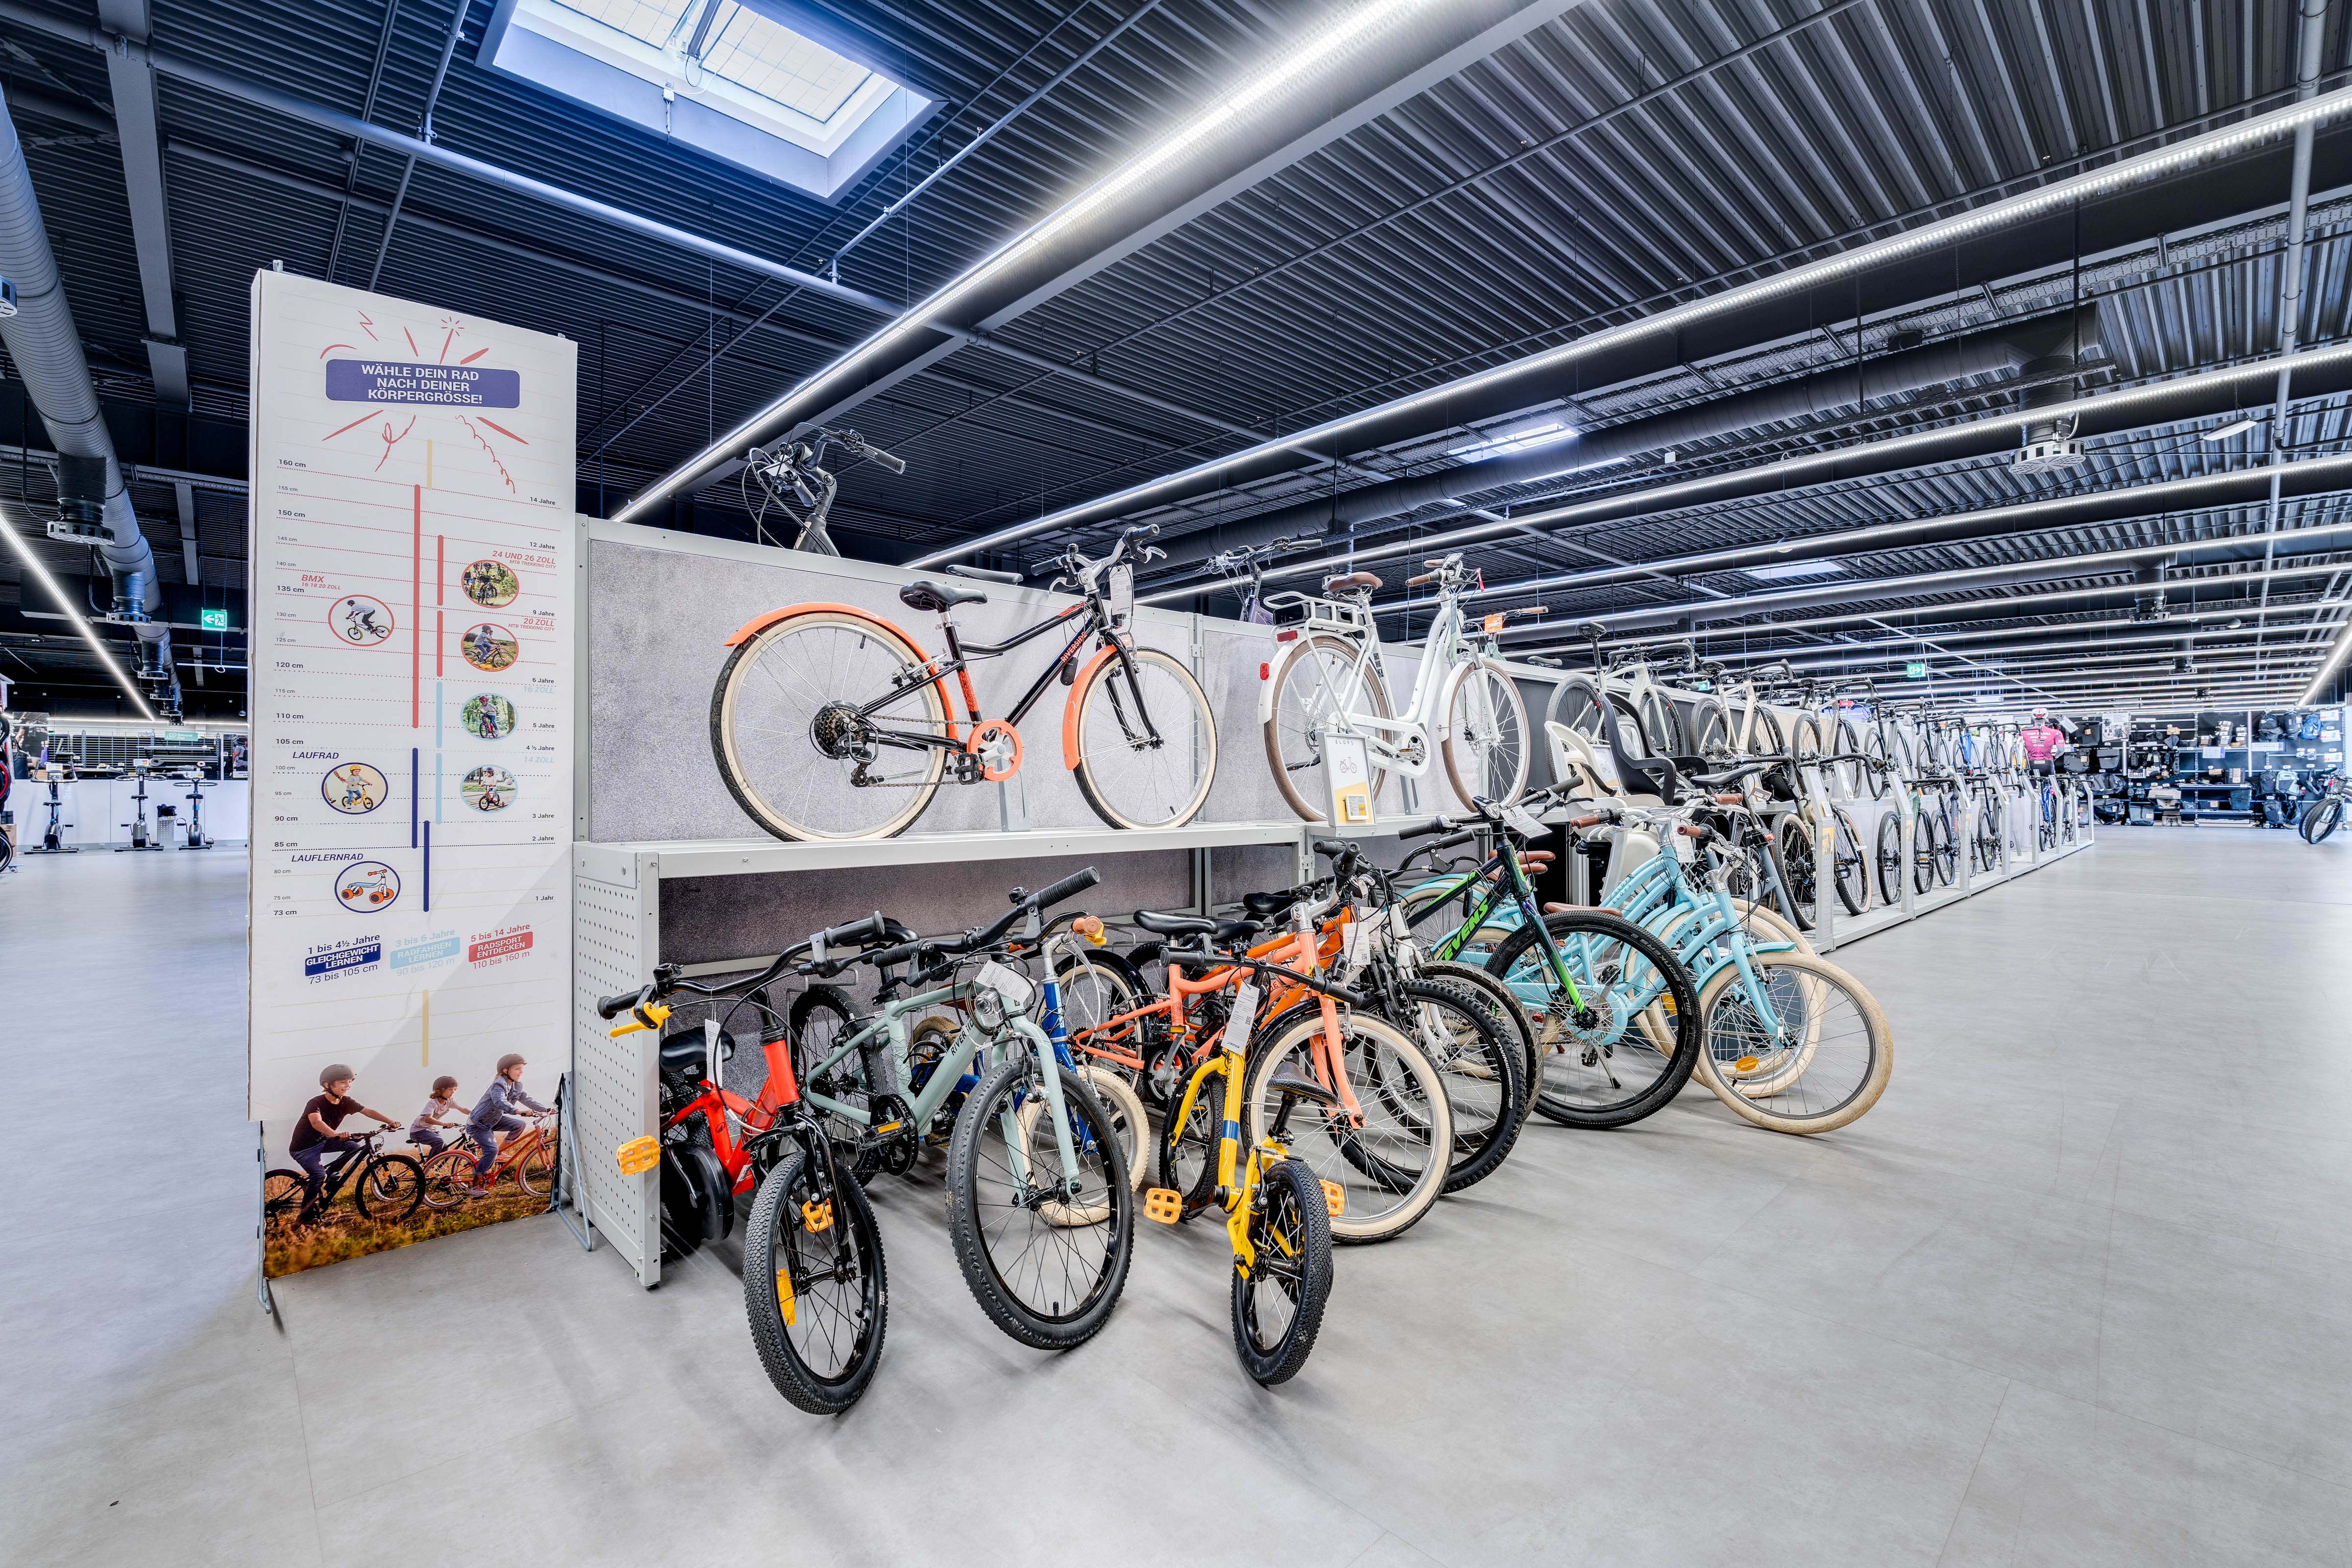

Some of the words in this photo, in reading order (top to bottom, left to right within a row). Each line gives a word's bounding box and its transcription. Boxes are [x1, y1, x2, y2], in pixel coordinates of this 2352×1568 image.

[361, 364, 411, 376] WÄHLE
[416, 368, 447, 379] DEIN
[452, 370, 479, 380] RAD
[377, 377, 416, 389] NACH
[421, 380, 469, 392] DEINER
[368, 388, 482, 404] KÖRPERGRÖSSE!
[536, 556, 556, 564] ZOLL
[301, 574, 324, 583] BMX
[1060, 631, 1087, 662] RIVERSIDE
[292, 853, 363, 862] LAUFLERNRAD
[1612, 885, 1631, 904] ELOPS
[430, 930, 455, 939] Jahre
[507, 924, 530, 934] Jahre
[1438, 898, 1488, 960] EVENS
[1671, 922, 1686, 937] BTWIN
[318, 944, 332, 953] bis
[352, 935, 380, 945] Jahre
[397, 941, 451, 958] RADFAHREN
[477, 942, 525, 958] ENTDECKEN
[478, 936, 522, 952] RADSPORT
[306, 945, 379, 966] GLEICHGEWICHT
[325, 955, 363, 969] LERNEN
[409, 950, 443, 963] LERNEN
[473, 960, 487, 969] 110
[505, 953, 519, 961] 160
[1640, 939, 1681, 981] BONKERS
[309, 976, 321, 984] 73
[325, 972, 339, 981] bis
[343, 967, 359, 977] 105
[396, 967, 408, 976] 90
[428, 960, 443, 969] 120
[951, 1013, 977, 1056] RIVERID
